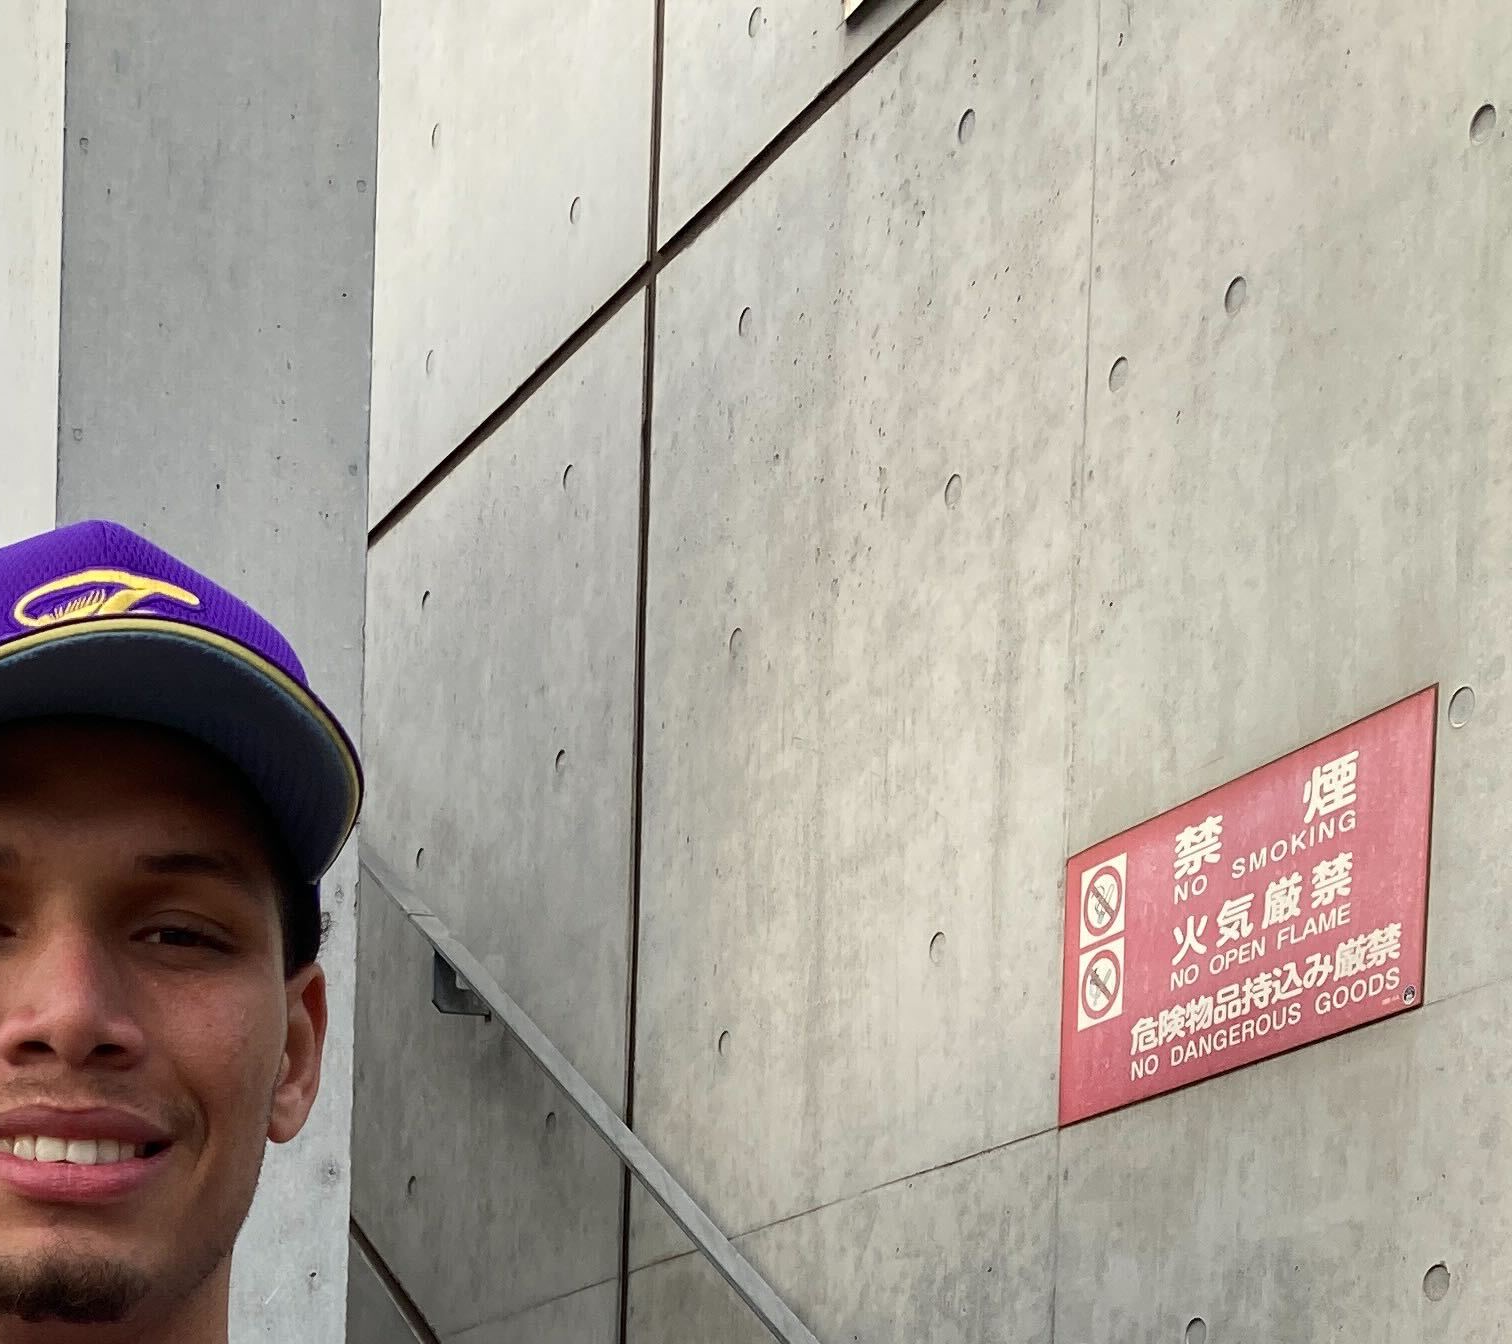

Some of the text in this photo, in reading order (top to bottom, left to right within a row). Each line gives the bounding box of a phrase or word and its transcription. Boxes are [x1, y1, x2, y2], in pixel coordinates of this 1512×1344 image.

[1171, 852, 1353, 966] 火気厳禁
[1173, 809, 1357, 905] NO SMOKING
[1129, 922, 1402, 1056] 危険物品持込み厳禁
[1170, 903, 1352, 991] NO OPEN FLAME
[1131, 966, 1401, 1082] NO DANGEROUS GOODS
